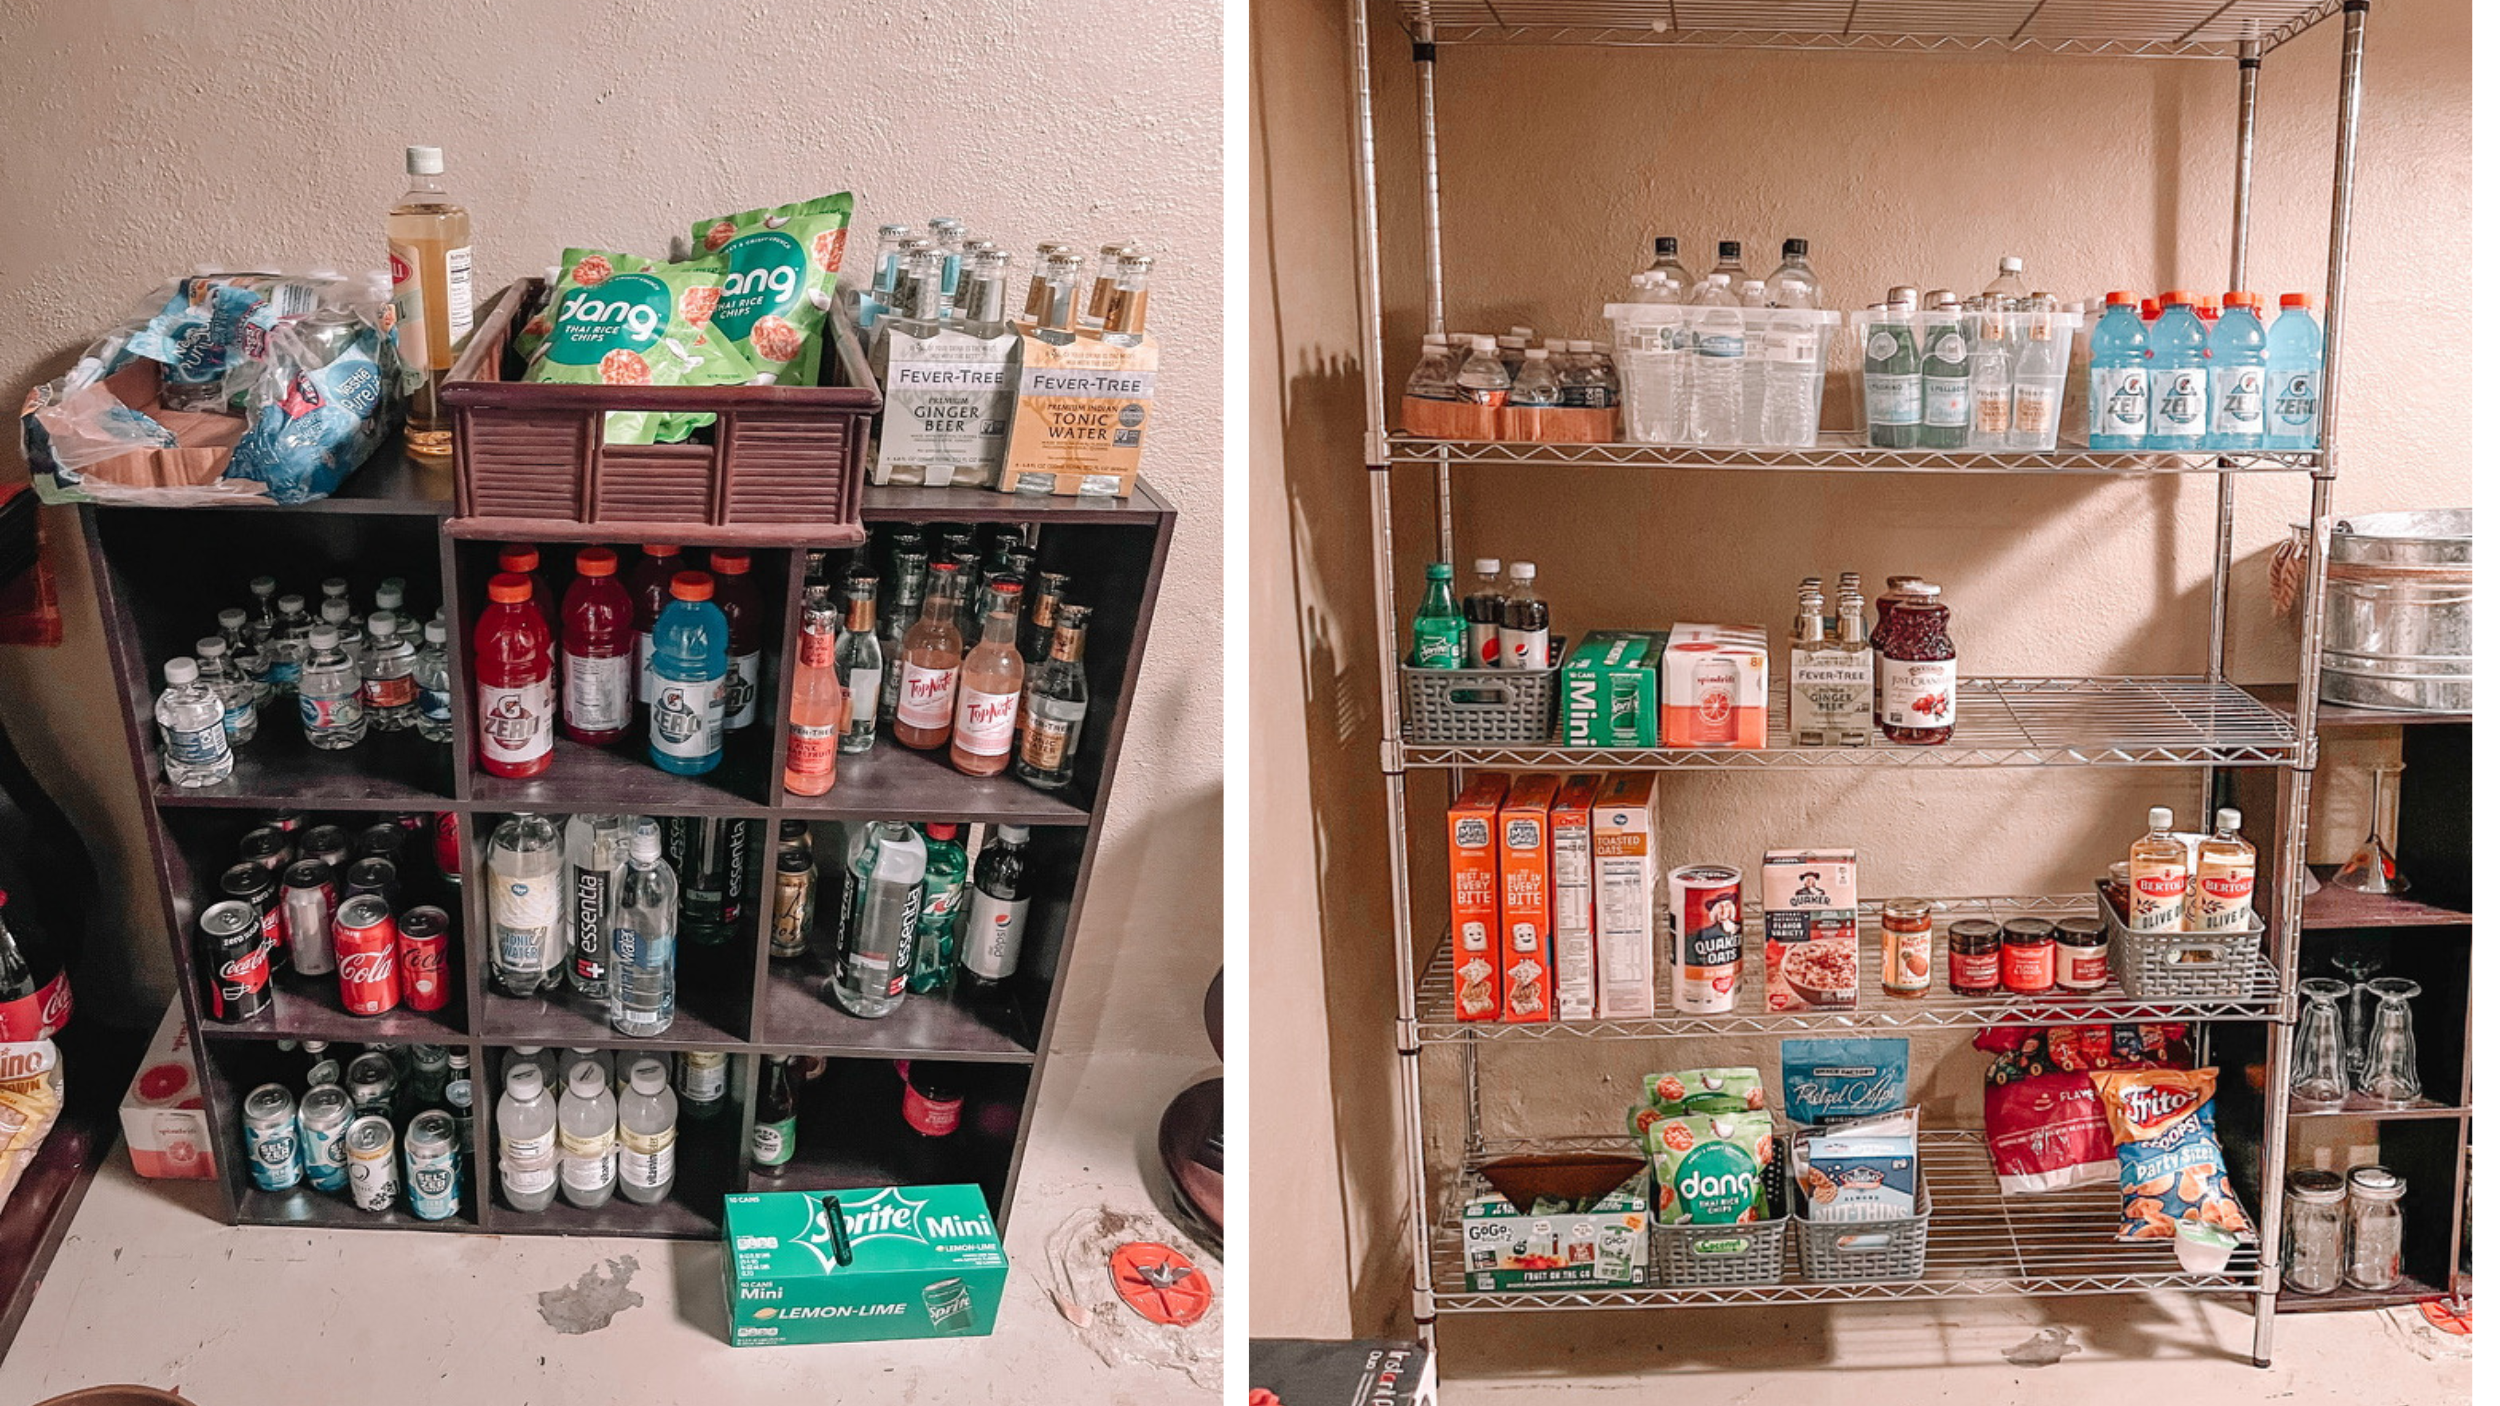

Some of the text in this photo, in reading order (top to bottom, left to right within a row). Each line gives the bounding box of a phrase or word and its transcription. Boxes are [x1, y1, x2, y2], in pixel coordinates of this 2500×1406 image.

[721, 265, 798, 303] ang
[738, 296, 764, 308] RICE
[557, 292, 659, 342] dang
[719, 307, 751, 320] CHIPS
[564, 325, 621, 335] THAI RICE
[570, 333, 605, 342] CHIPS
[899, 369, 1005, 384] FEVER-TREE
[1033, 375, 1142, 392] FEVER-TREE
[914, 405, 979, 418] GINGER
[2274, 398, 2317, 415] ZERO
[925, 420, 966, 432] BEER
[1052, 412, 1109, 426] TONIC
[1048, 426, 1108, 440] WATER
[1697, 675, 1736, 686] spindrift
[1798, 670, 1865, 680] FEVER-TREE
[1810, 693, 1853, 702] GINGER
[652, 706, 702, 735] ZERO
[1569, 680, 1598, 747] Mini
[485, 716, 540, 739] ZERO
[1597, 836, 1641, 846] TOASTED
[1597, 846, 1622, 855] OATS
[729, 820, 746, 897] essentia
[1457, 880, 1490, 890] EVERY
[1508, 881, 1541, 892] EVERY
[1458, 891, 1492, 905] BITE
[1508, 893, 1542, 905] BITE
[1789, 896, 1831, 907] QUAKER
[580, 874, 598, 953] essentia
[2142, 907, 2172, 930] OLIVE
[2206, 909, 2238, 930] OLIVE
[896, 887, 923, 969] essentia
[1708, 950, 1737, 965] OATS
[1793, 1081, 1847, 1113] Pretzel
[2137, 1145, 2215, 1180] Party Size!
[1680, 1170, 1756, 1200] dang
[1699, 1198, 1739, 1207] THAI RICE
[1707, 1206, 1733, 1214] CHIPS
[926, 1214, 992, 1239] Mini
[945, 1243, 997, 1252] LEMON-LIME
[1524, 1272, 1548, 1281] FRUIT
[741, 1287, 783, 1299] Mini
[778, 1303, 908, 1320] LEMON-LIME
